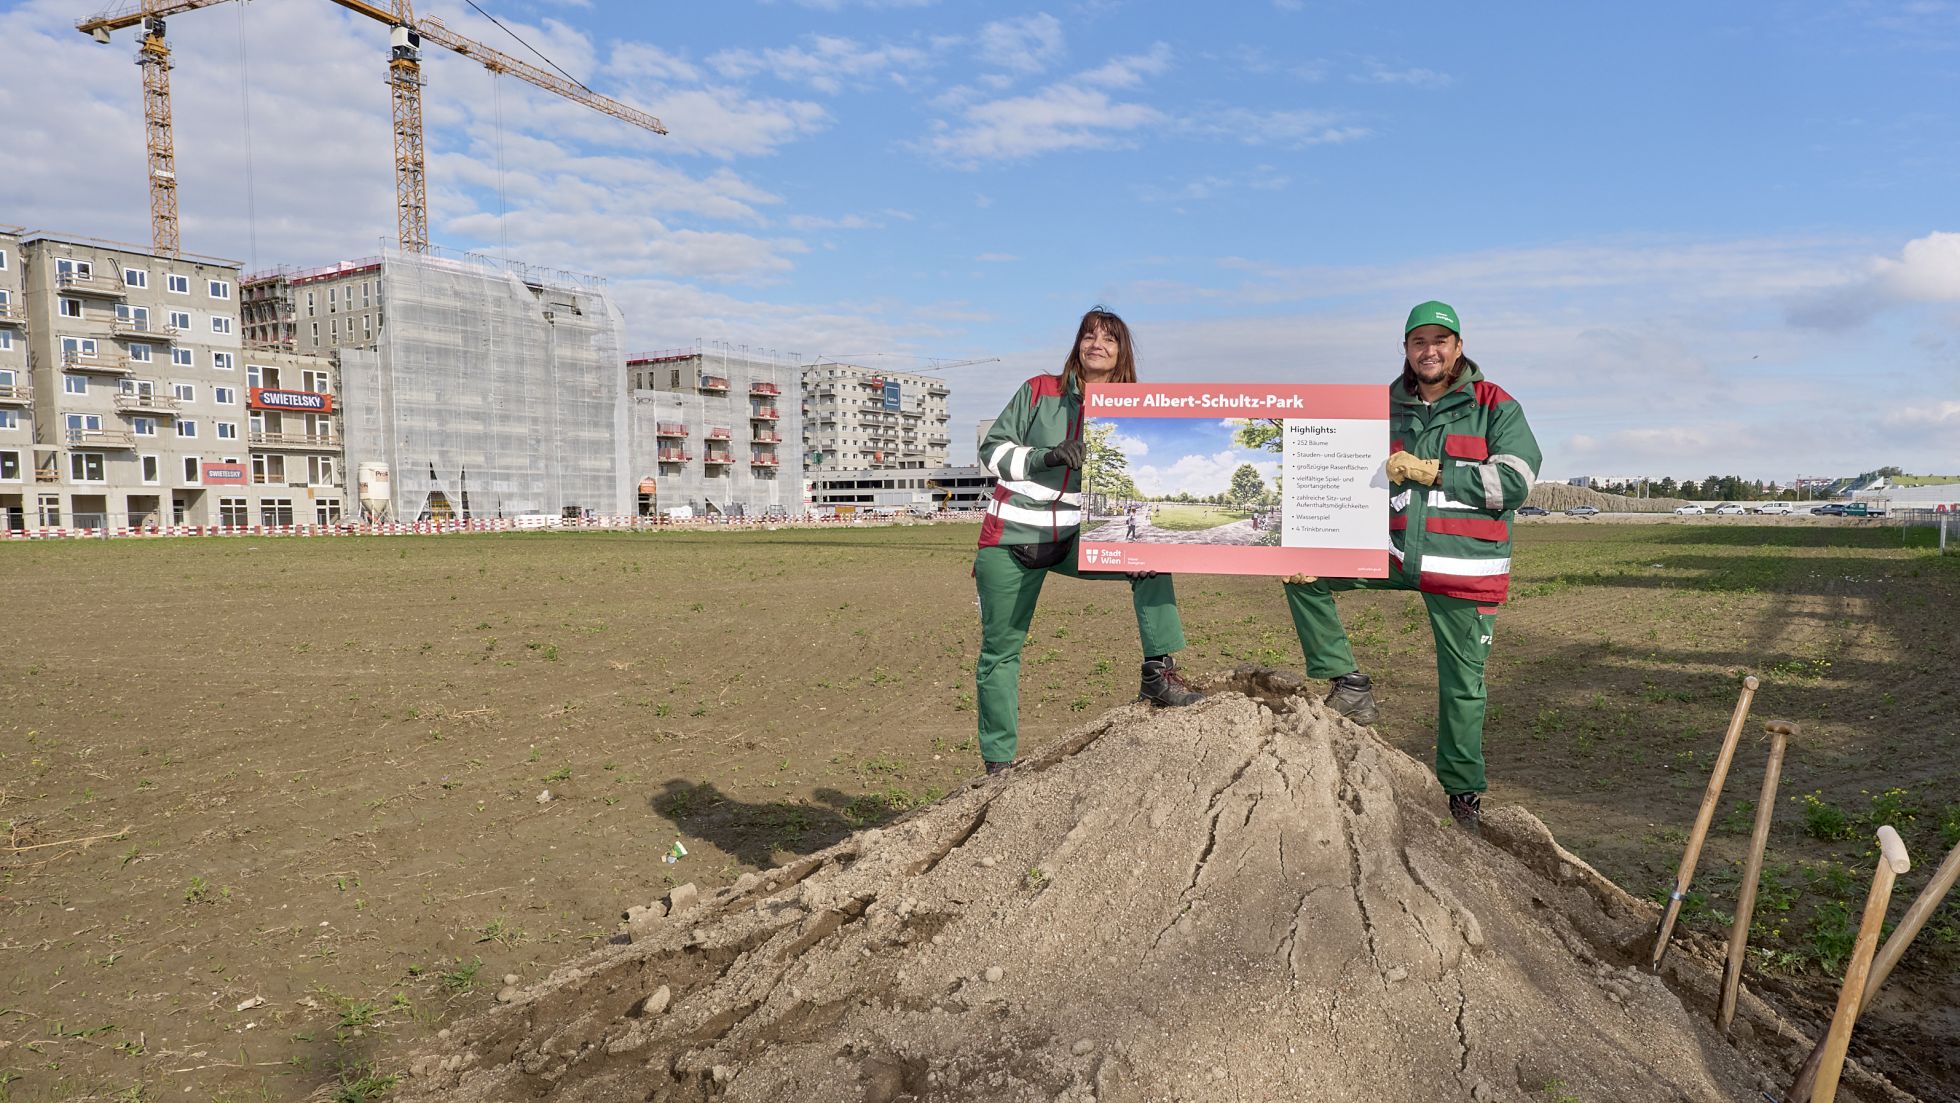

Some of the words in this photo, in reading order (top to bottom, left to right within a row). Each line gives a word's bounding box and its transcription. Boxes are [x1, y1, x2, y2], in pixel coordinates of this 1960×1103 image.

[263, 392, 321, 407] SWIETELSKY
[1091, 393, 1140, 407] Neuer
[1143, 393, 1304, 409] Albert-Schultz-Park
[1290, 425, 1337, 435] Highlights:
[208, 470, 241, 479] SWIETELSKY
[1296, 482, 1340, 490] Sportangebote
[1101, 557, 1121, 565] Wien
